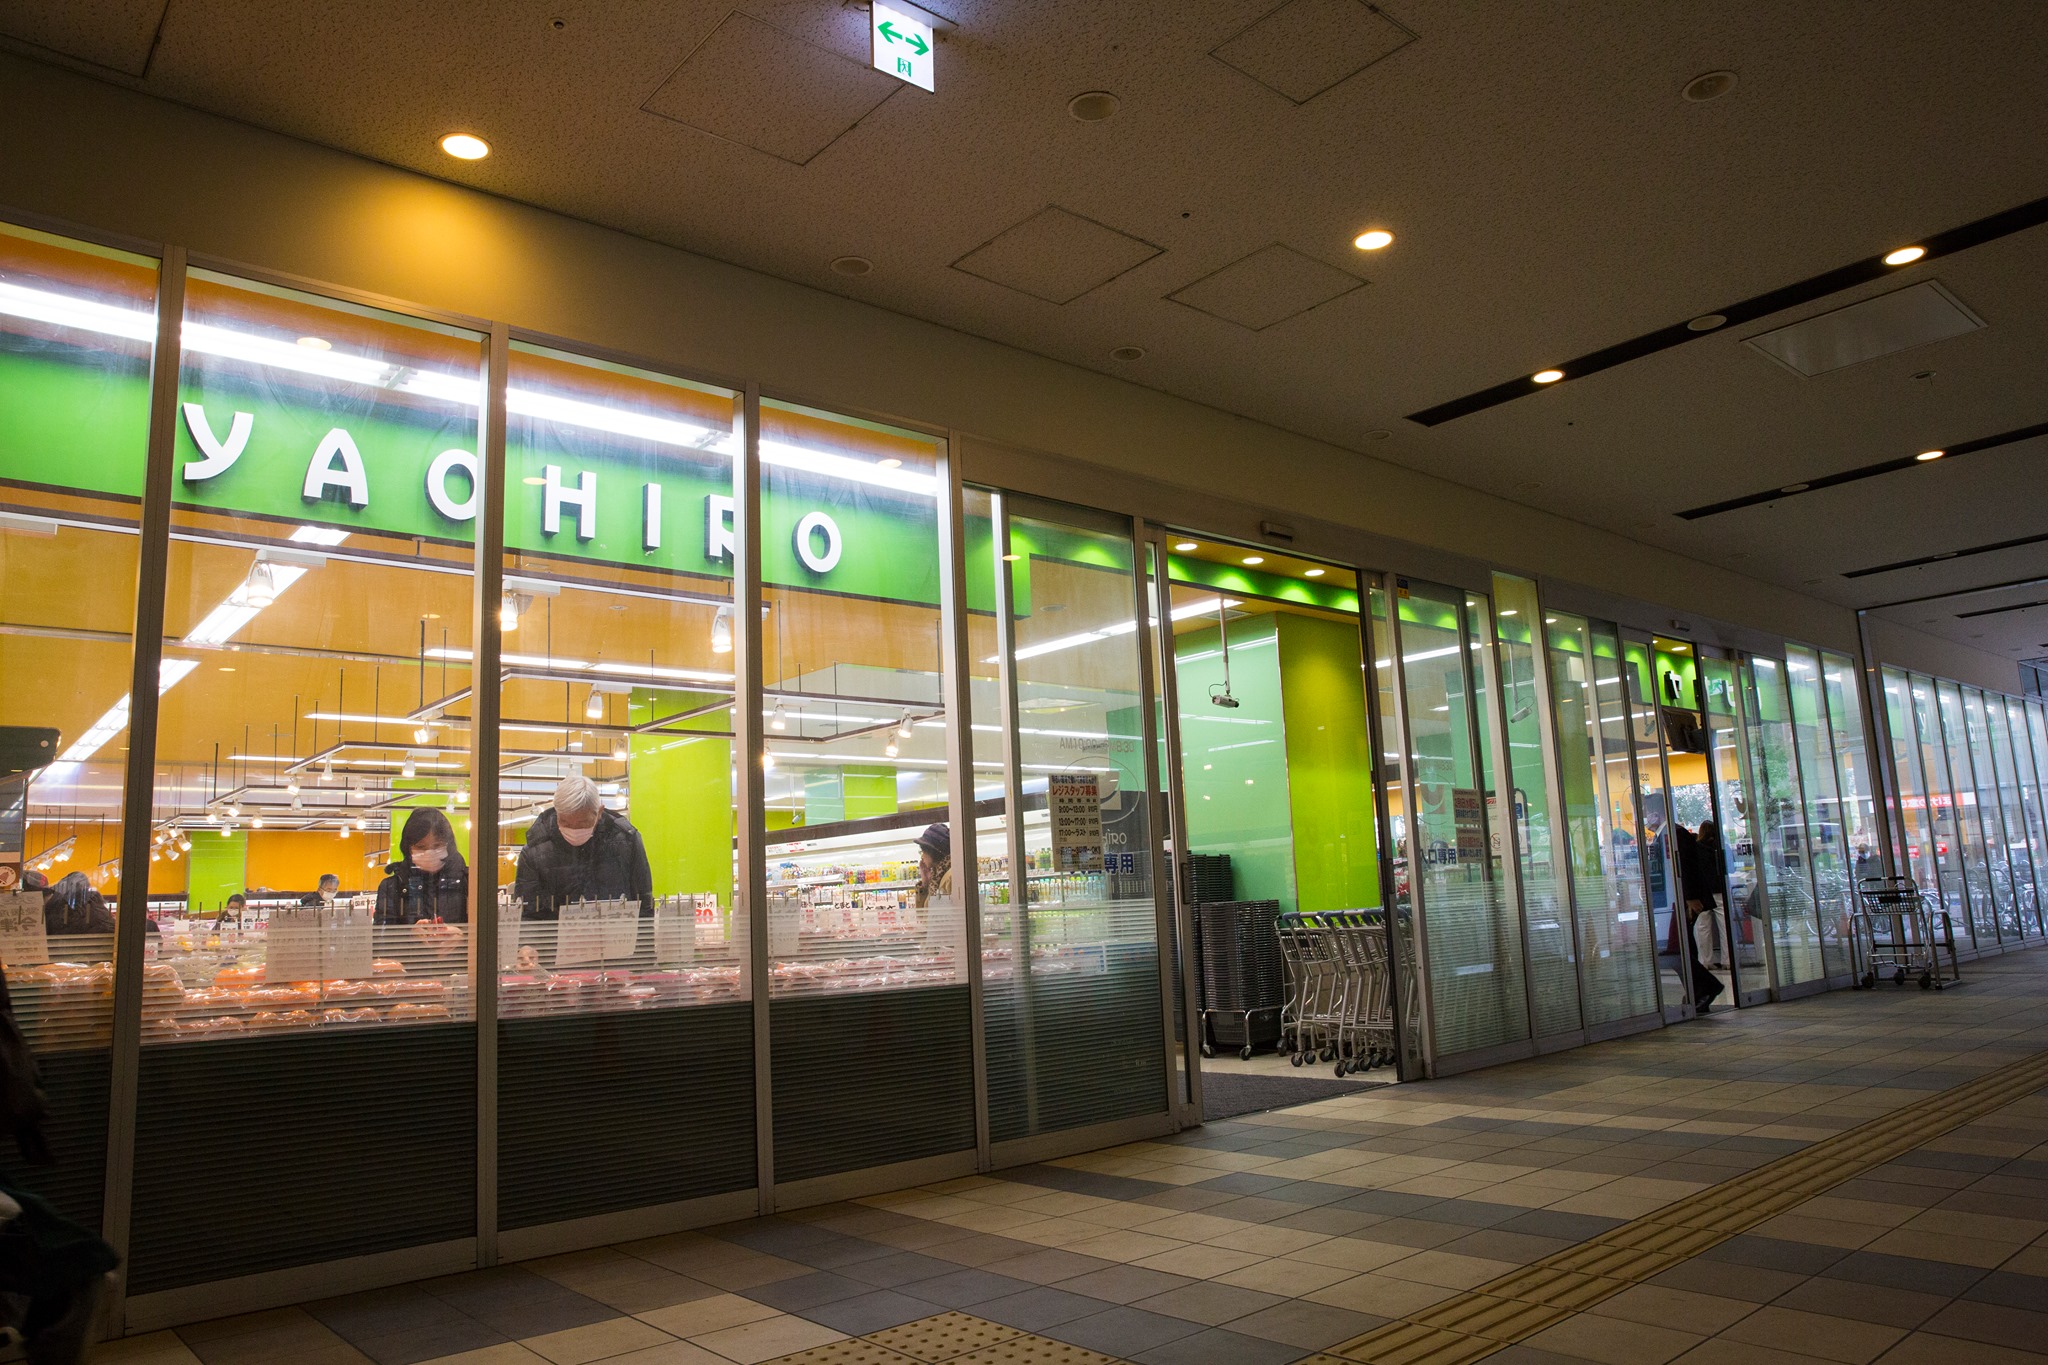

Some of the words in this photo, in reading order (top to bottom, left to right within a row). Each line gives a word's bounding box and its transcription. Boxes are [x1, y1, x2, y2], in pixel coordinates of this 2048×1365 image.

[181, 402, 843, 574] YAOHIRO
[1052, 785, 1097, 796] レジスタッフ募集
